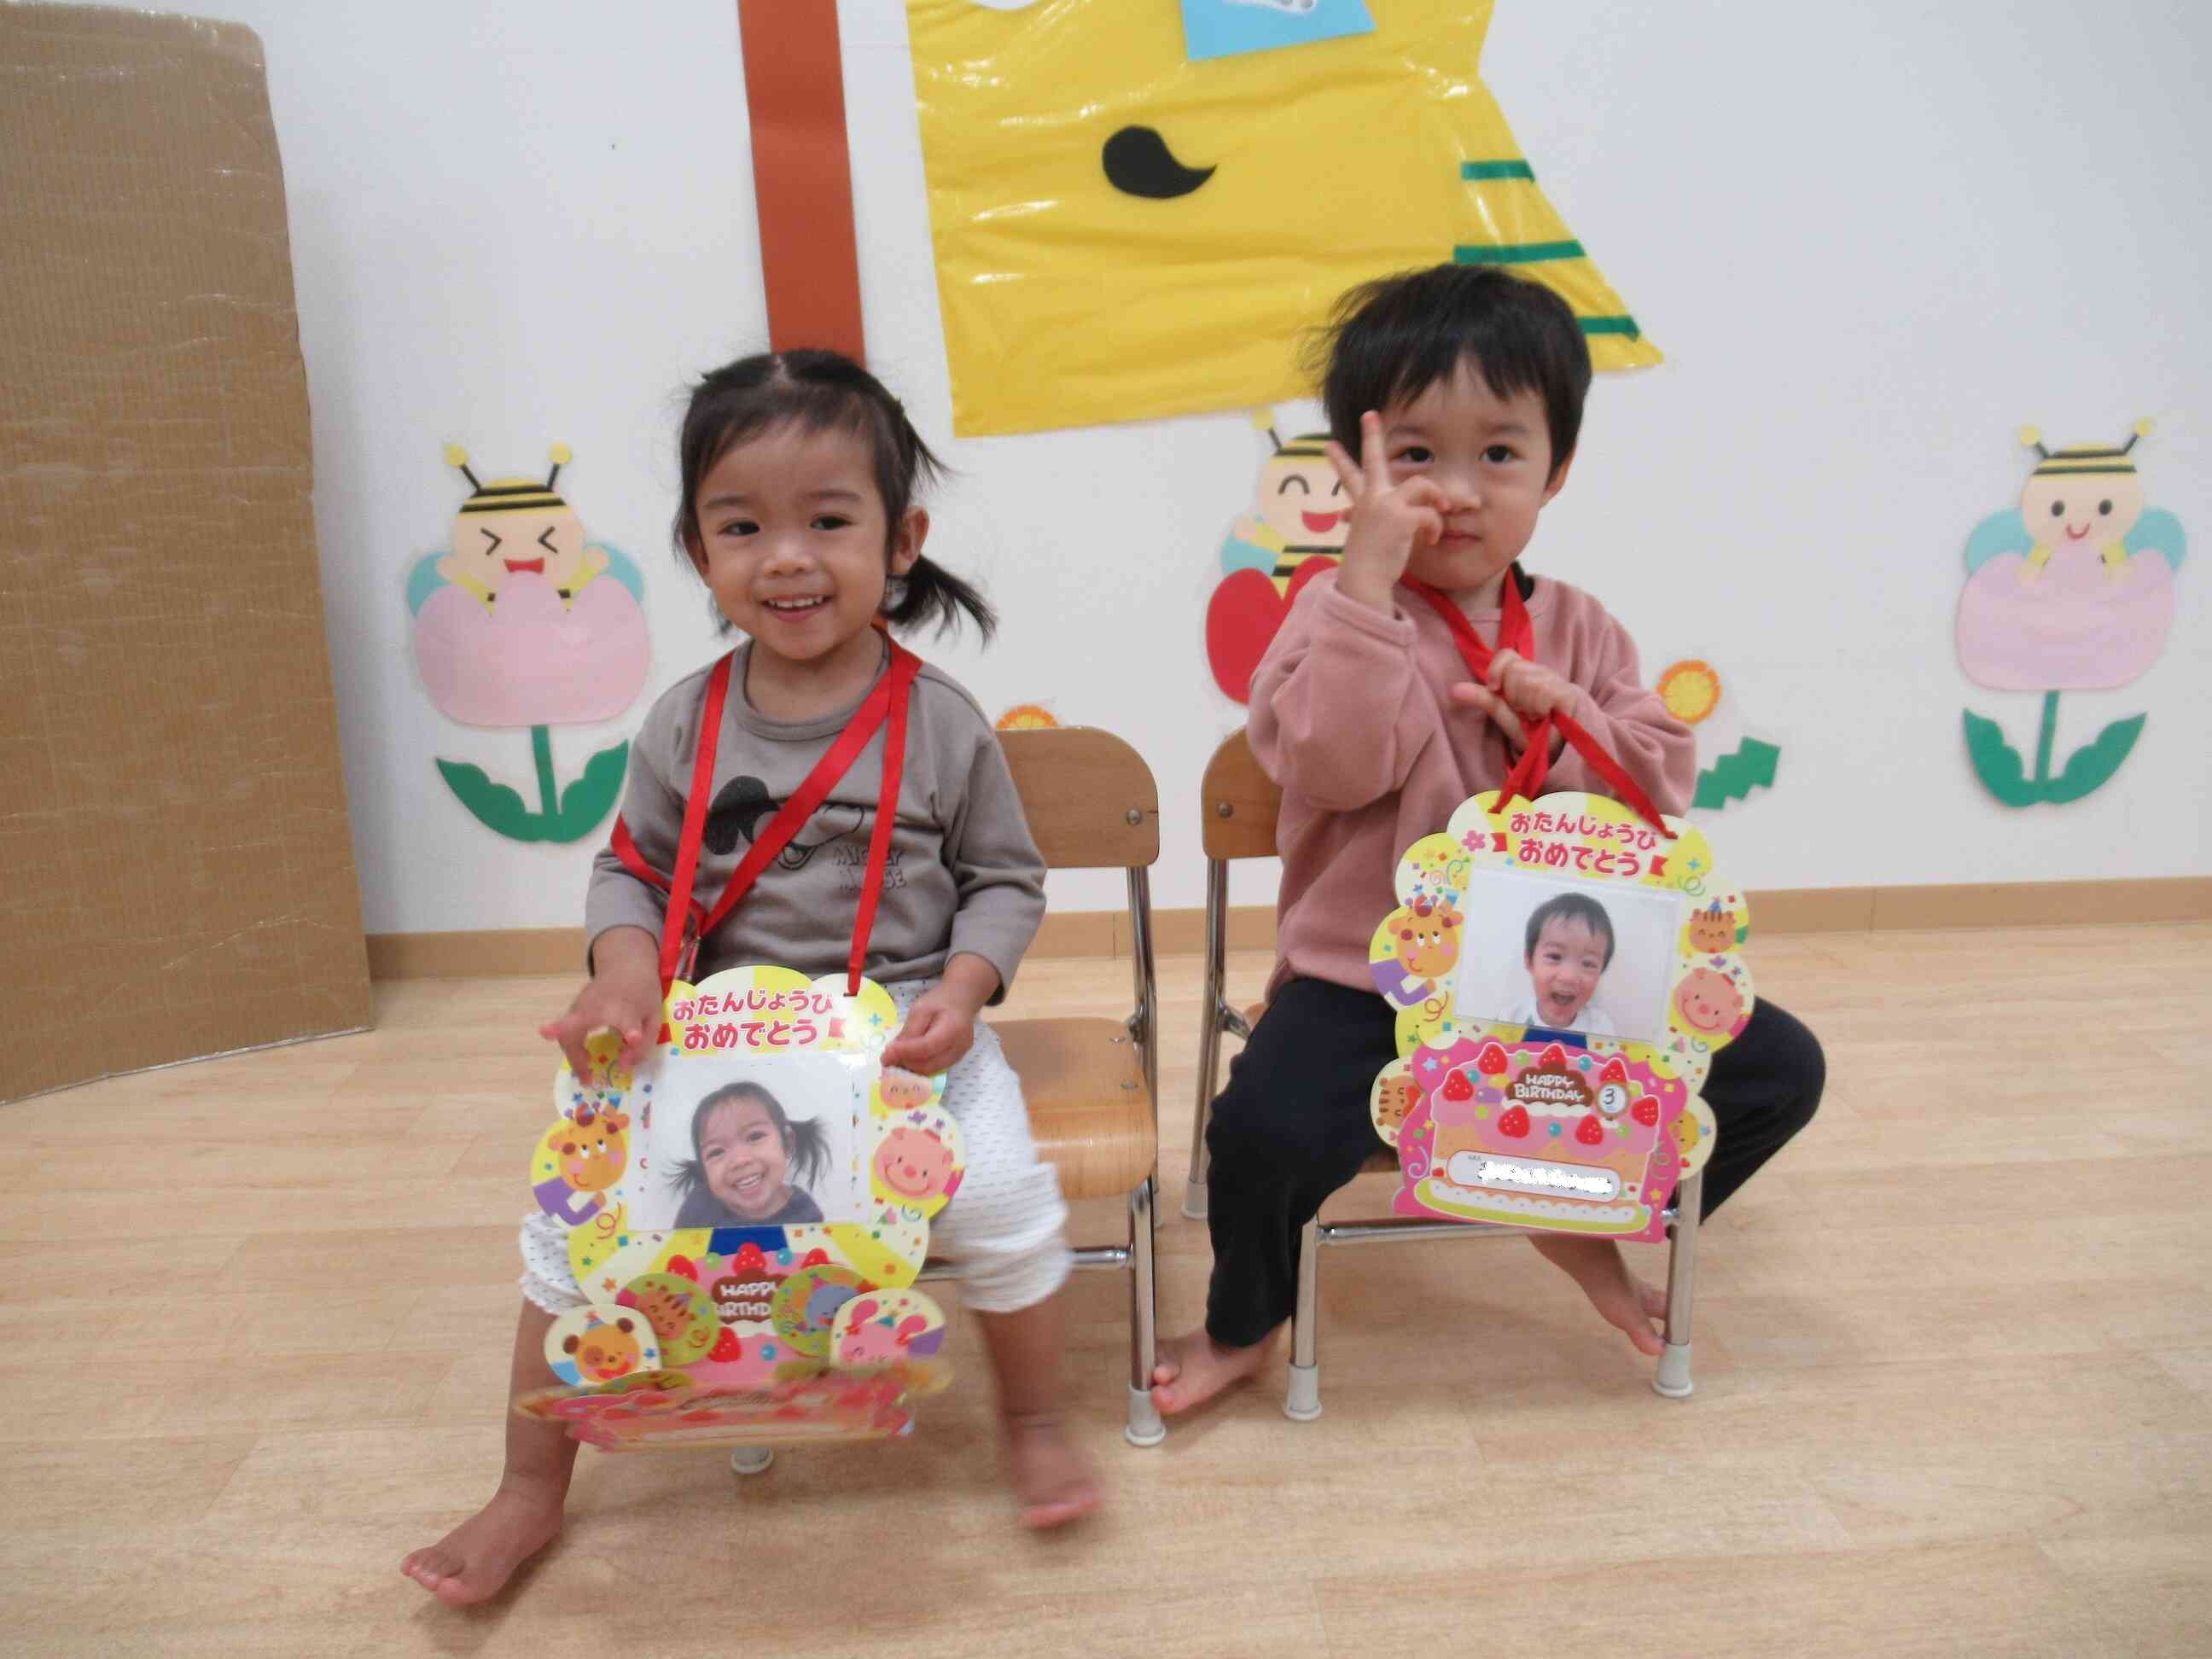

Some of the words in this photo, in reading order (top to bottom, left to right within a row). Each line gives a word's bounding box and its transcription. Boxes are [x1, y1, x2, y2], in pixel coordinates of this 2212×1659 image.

[1510, 812, 1656, 851] おたんじょうび
[1518, 838, 1640, 876] おめでとう
[672, 989, 834, 1021] おたんじょうび
[684, 1019, 818, 1050] おめでとう
[1514, 1083, 1585, 1103] BIRTHDAY
[1525, 1073, 1575, 1089] HAPPY
[1604, 1087, 1615, 1105] 3
[717, 1301, 772, 1318] IRTHD
